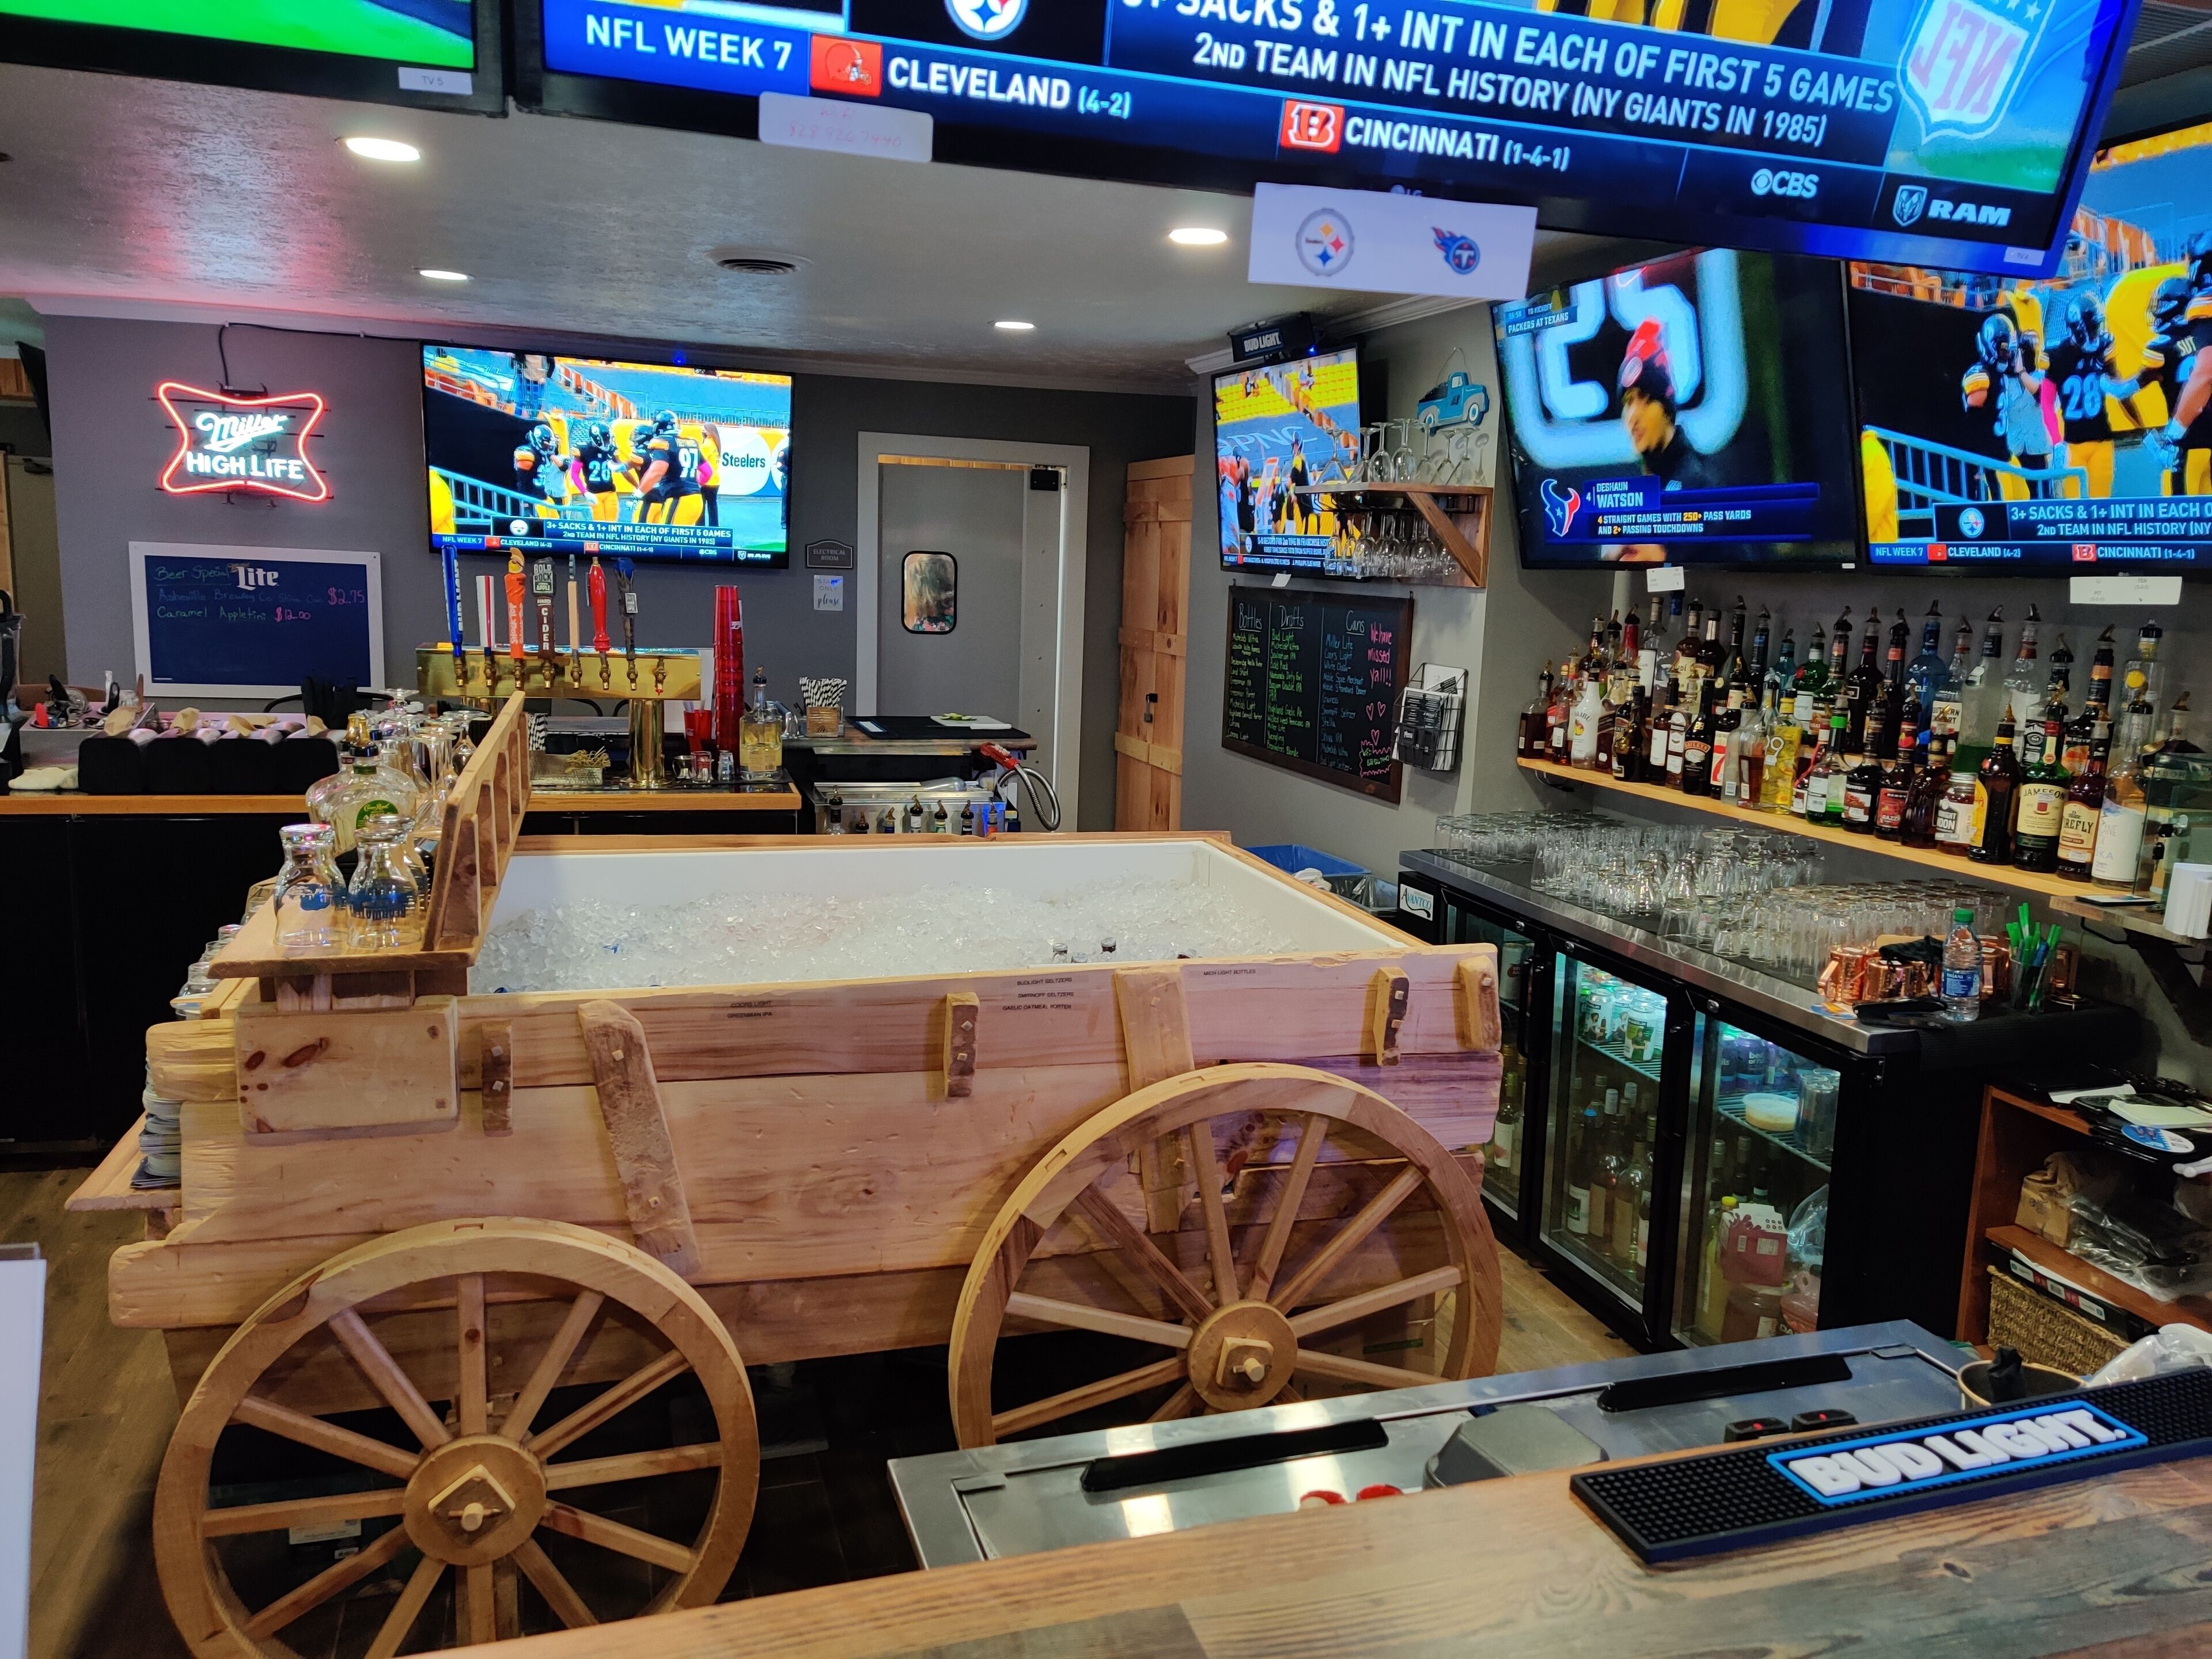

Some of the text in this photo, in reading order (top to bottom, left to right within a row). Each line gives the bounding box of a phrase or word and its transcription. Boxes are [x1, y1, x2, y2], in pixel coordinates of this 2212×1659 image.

[586, 14, 793, 71] NFL WEEK 7
[1353, 3, 1392, 41] 1+
[1400, 10, 1464, 54] INT
[1468, 20, 1508, 60] IN
[1514, 26, 1608, 74] EACH
[1614, 41, 1661, 79] OF
[1664, 48, 1761, 94] FIRST
[1763, 63, 1785, 99] 5
[1788, 67, 1896, 113] GAMES
[421, 75, 444, 86] TV 5
[888, 56, 1132, 119] CLEVELAND (4-2)
[1192, 32, 1827, 148] 2ND TEAM IN NFL HISTORY (NY GIANTS IN 1985)
[1346, 116, 1571, 172] CINCINNATI (1-4-1)
[1771, 172, 1819, 198] CBS
[1928, 199, 2012, 226] RAM
[1508, 312, 1569, 334] PACKERS AT TEXANS
[1259, 332, 1282, 349] LIGHT
[2063, 374, 2102, 421] 28
[196, 412, 289, 453] Miller
[187, 451, 305, 479] HIGH LIFE
[722, 452, 766, 468] Steelers
[1586, 481, 1628, 501] 4 DESHAUN
[1596, 492, 1643, 508] WATSON
[1597, 516, 1603, 524] 4
[1603, 514, 1635, 524] STRAIGHT
[1637, 513, 1662, 522] GAMES
[1663, 512, 1681, 522] WITH
[1703, 511, 1724, 521] PASS
[1725, 510, 1751, 520] YARDS
[2011, 502, 2200, 520] 3+ SACKS & 1+ INT IN EACH
[547, 521, 556, 529] 3+
[558, 521, 586, 530] SACKS
[608, 524, 622, 532] INT
[635, 526, 657, 534] EACH
[671, 528, 695, 536] FIRST
[703, 529, 732, 537] GAMES
[621, 533, 649, 542] HISTORY
[1598, 525, 1612, 535] AND
[1622, 524, 1652, 533] PASSING
[1653, 523, 1703, 533] TOUCHDOWNS
[2058, 523, 2089, 536] TEAM
[2092, 523, 2104, 535] IN
[2107, 523, 2131, 535] NFL
[2134, 522, 2187, 535] HISTORY
[500, 539, 539, 547] CLEVELAND
[599, 543, 636, 552] CINCINNATI
[1876, 547, 1923, 556] NFL WEEK 7
[1948, 547, 2001, 557] CLEVELAND
[2097, 547, 2161, 558] CINCINNATI
[154, 566, 188, 581] Beer
[236, 566, 279, 591] Lite
[533, 564, 551, 575] BOLD
[534, 572, 551, 581] ROCK
[214, 588, 255, 604] Brewing
[328, 586, 365, 606] $2.75
[817, 593, 840, 609] please
[157, 605, 208, 619] Caramel
[219, 606, 267, 622] Appletini
[1239, 603, 1262, 630] Bottles
[1279, 605, 1304, 628] Drafts
[1346, 610, 1365, 633] Cans
[541, 607, 550, 650] CIDER
[1378, 623, 1392, 645] have
[1326, 634, 1353, 649] Miller Lite
[1368, 647, 1391, 664] missed
[1402, 888, 1431, 910] AVANTCO
[1788, 1409, 2126, 1497] BUD LIGHT
